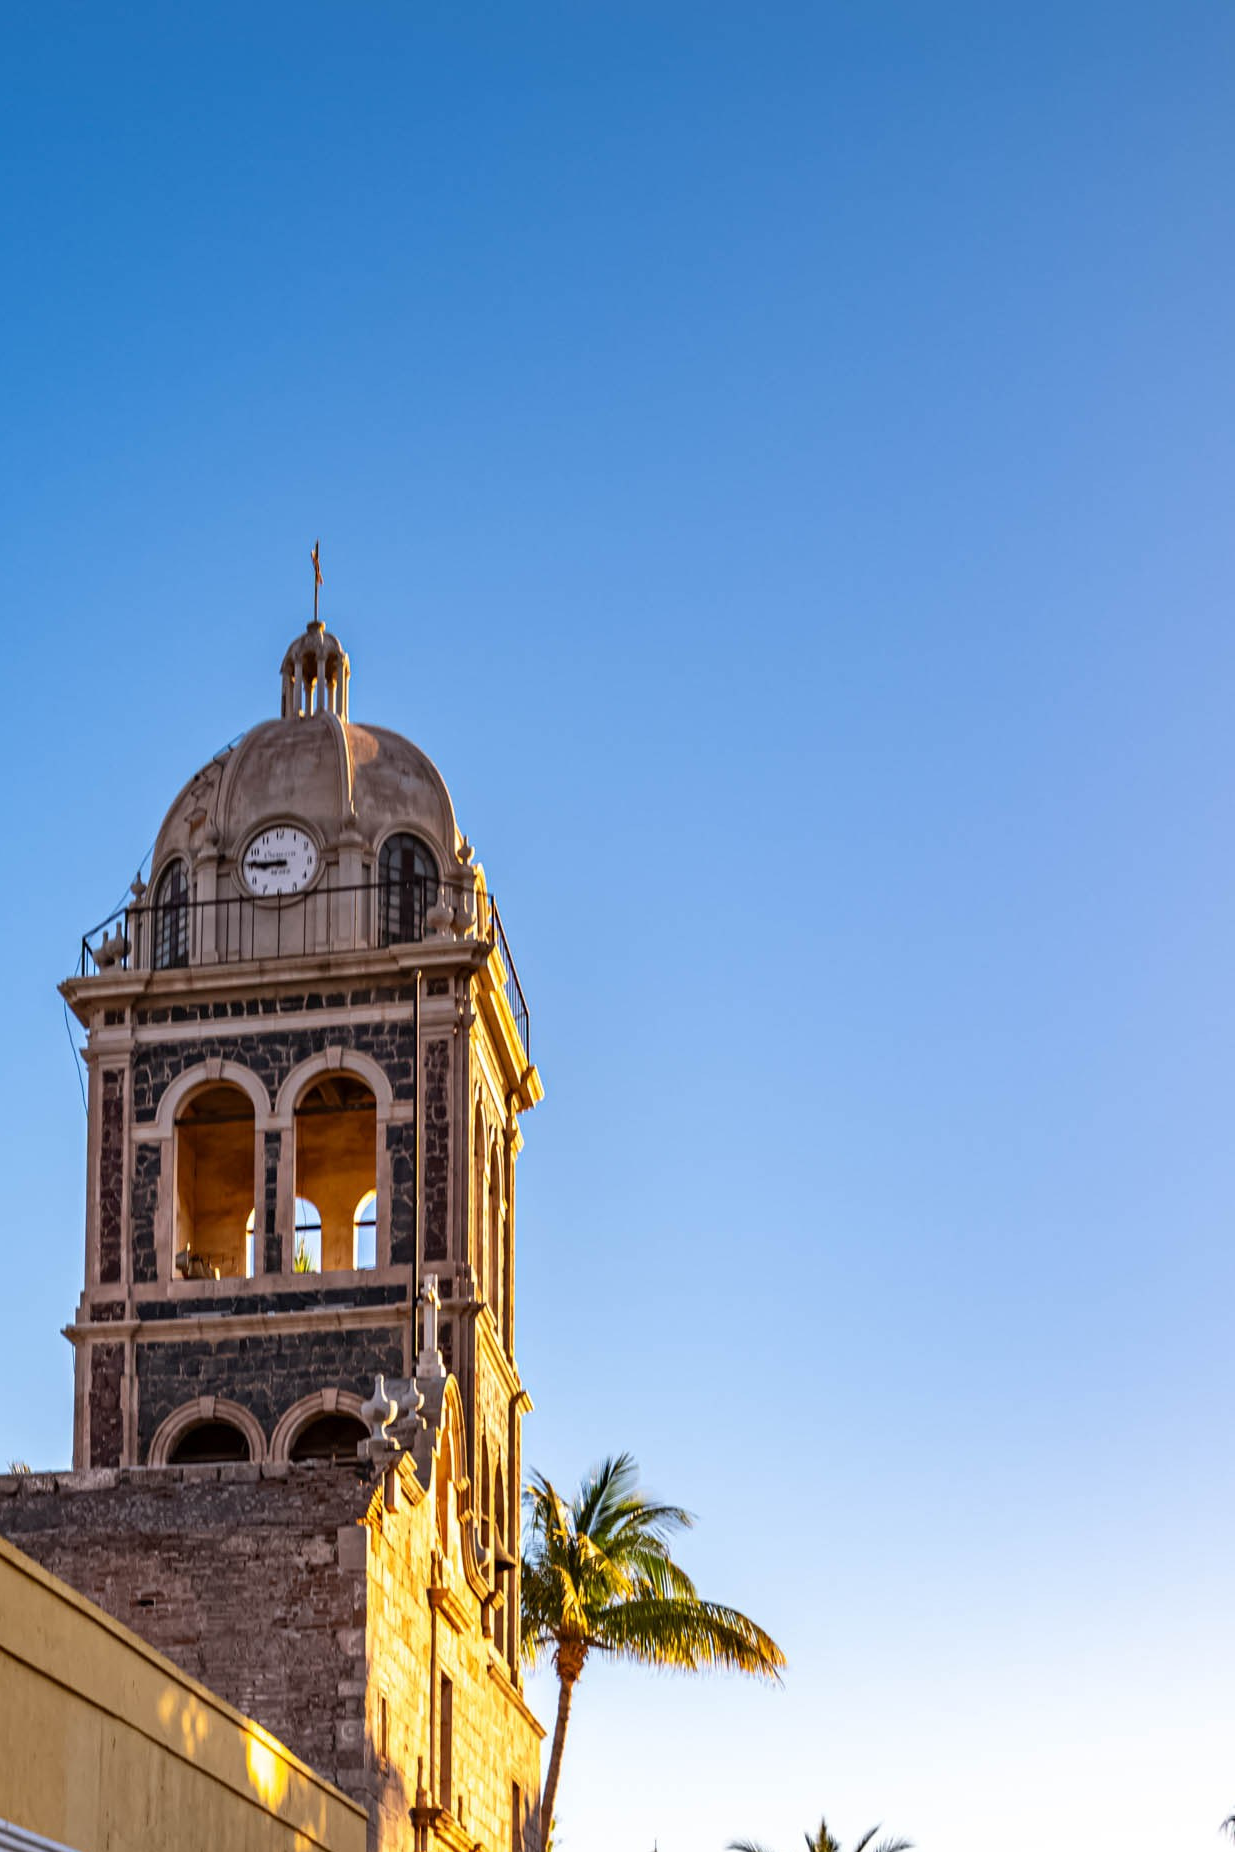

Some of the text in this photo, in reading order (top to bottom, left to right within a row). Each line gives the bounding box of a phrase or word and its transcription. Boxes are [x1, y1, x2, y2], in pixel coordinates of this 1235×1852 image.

[276, 829, 285, 840] 12
[262, 835, 269, 845] 11
[251, 847, 260, 857] 10
